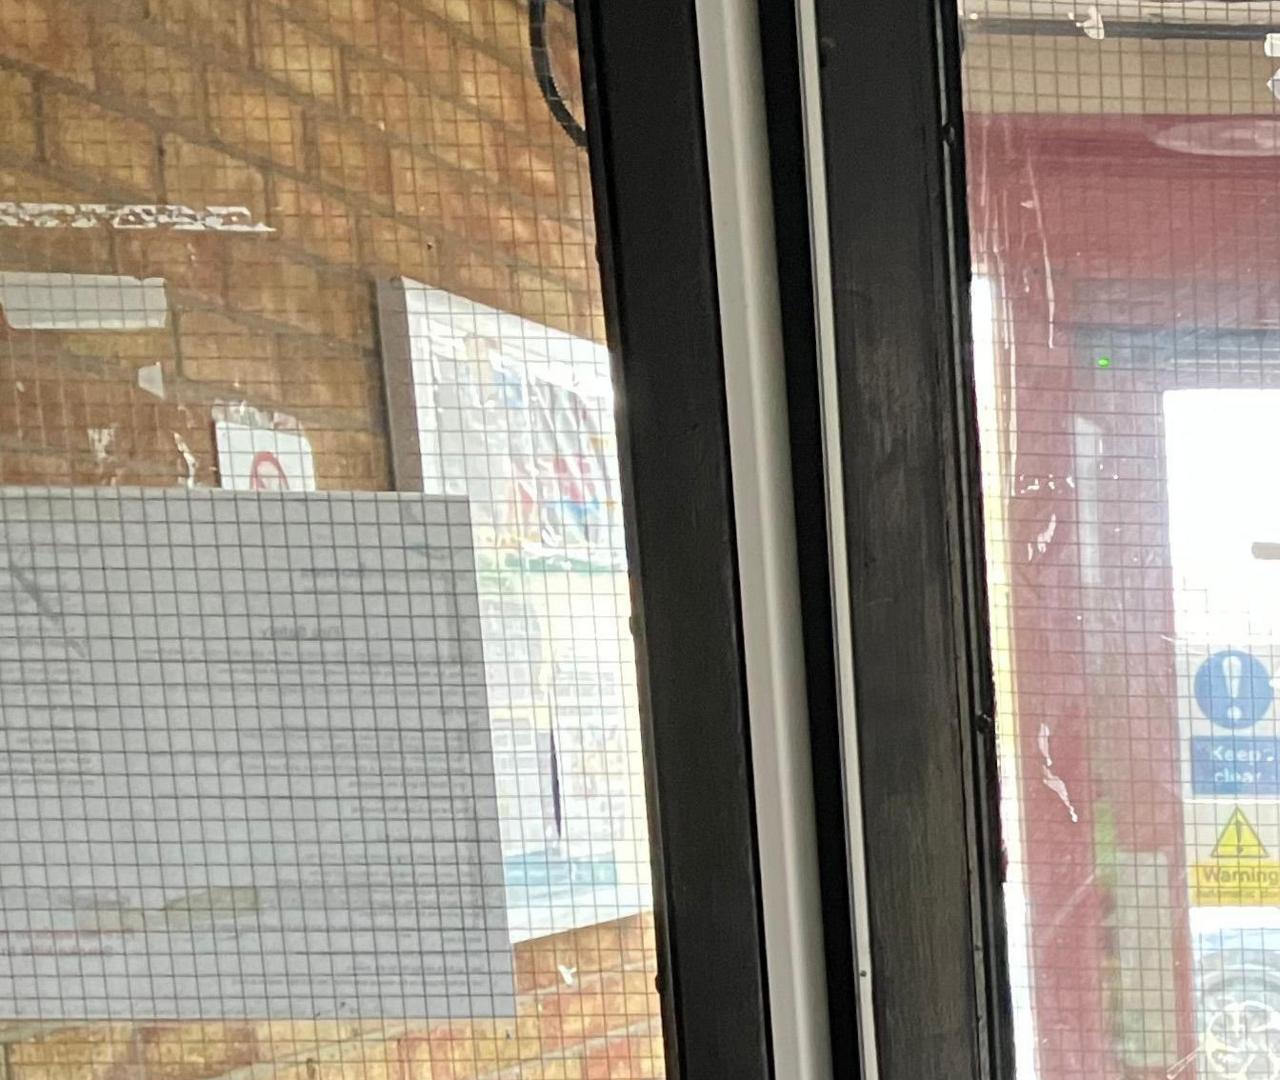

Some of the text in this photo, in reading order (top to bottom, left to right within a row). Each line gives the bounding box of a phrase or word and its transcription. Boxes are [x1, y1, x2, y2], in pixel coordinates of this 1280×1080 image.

[1210, 745, 1262, 766] Keep
[1214, 768, 1262, 783] clear
[1203, 866, 1280, 885] Warning
